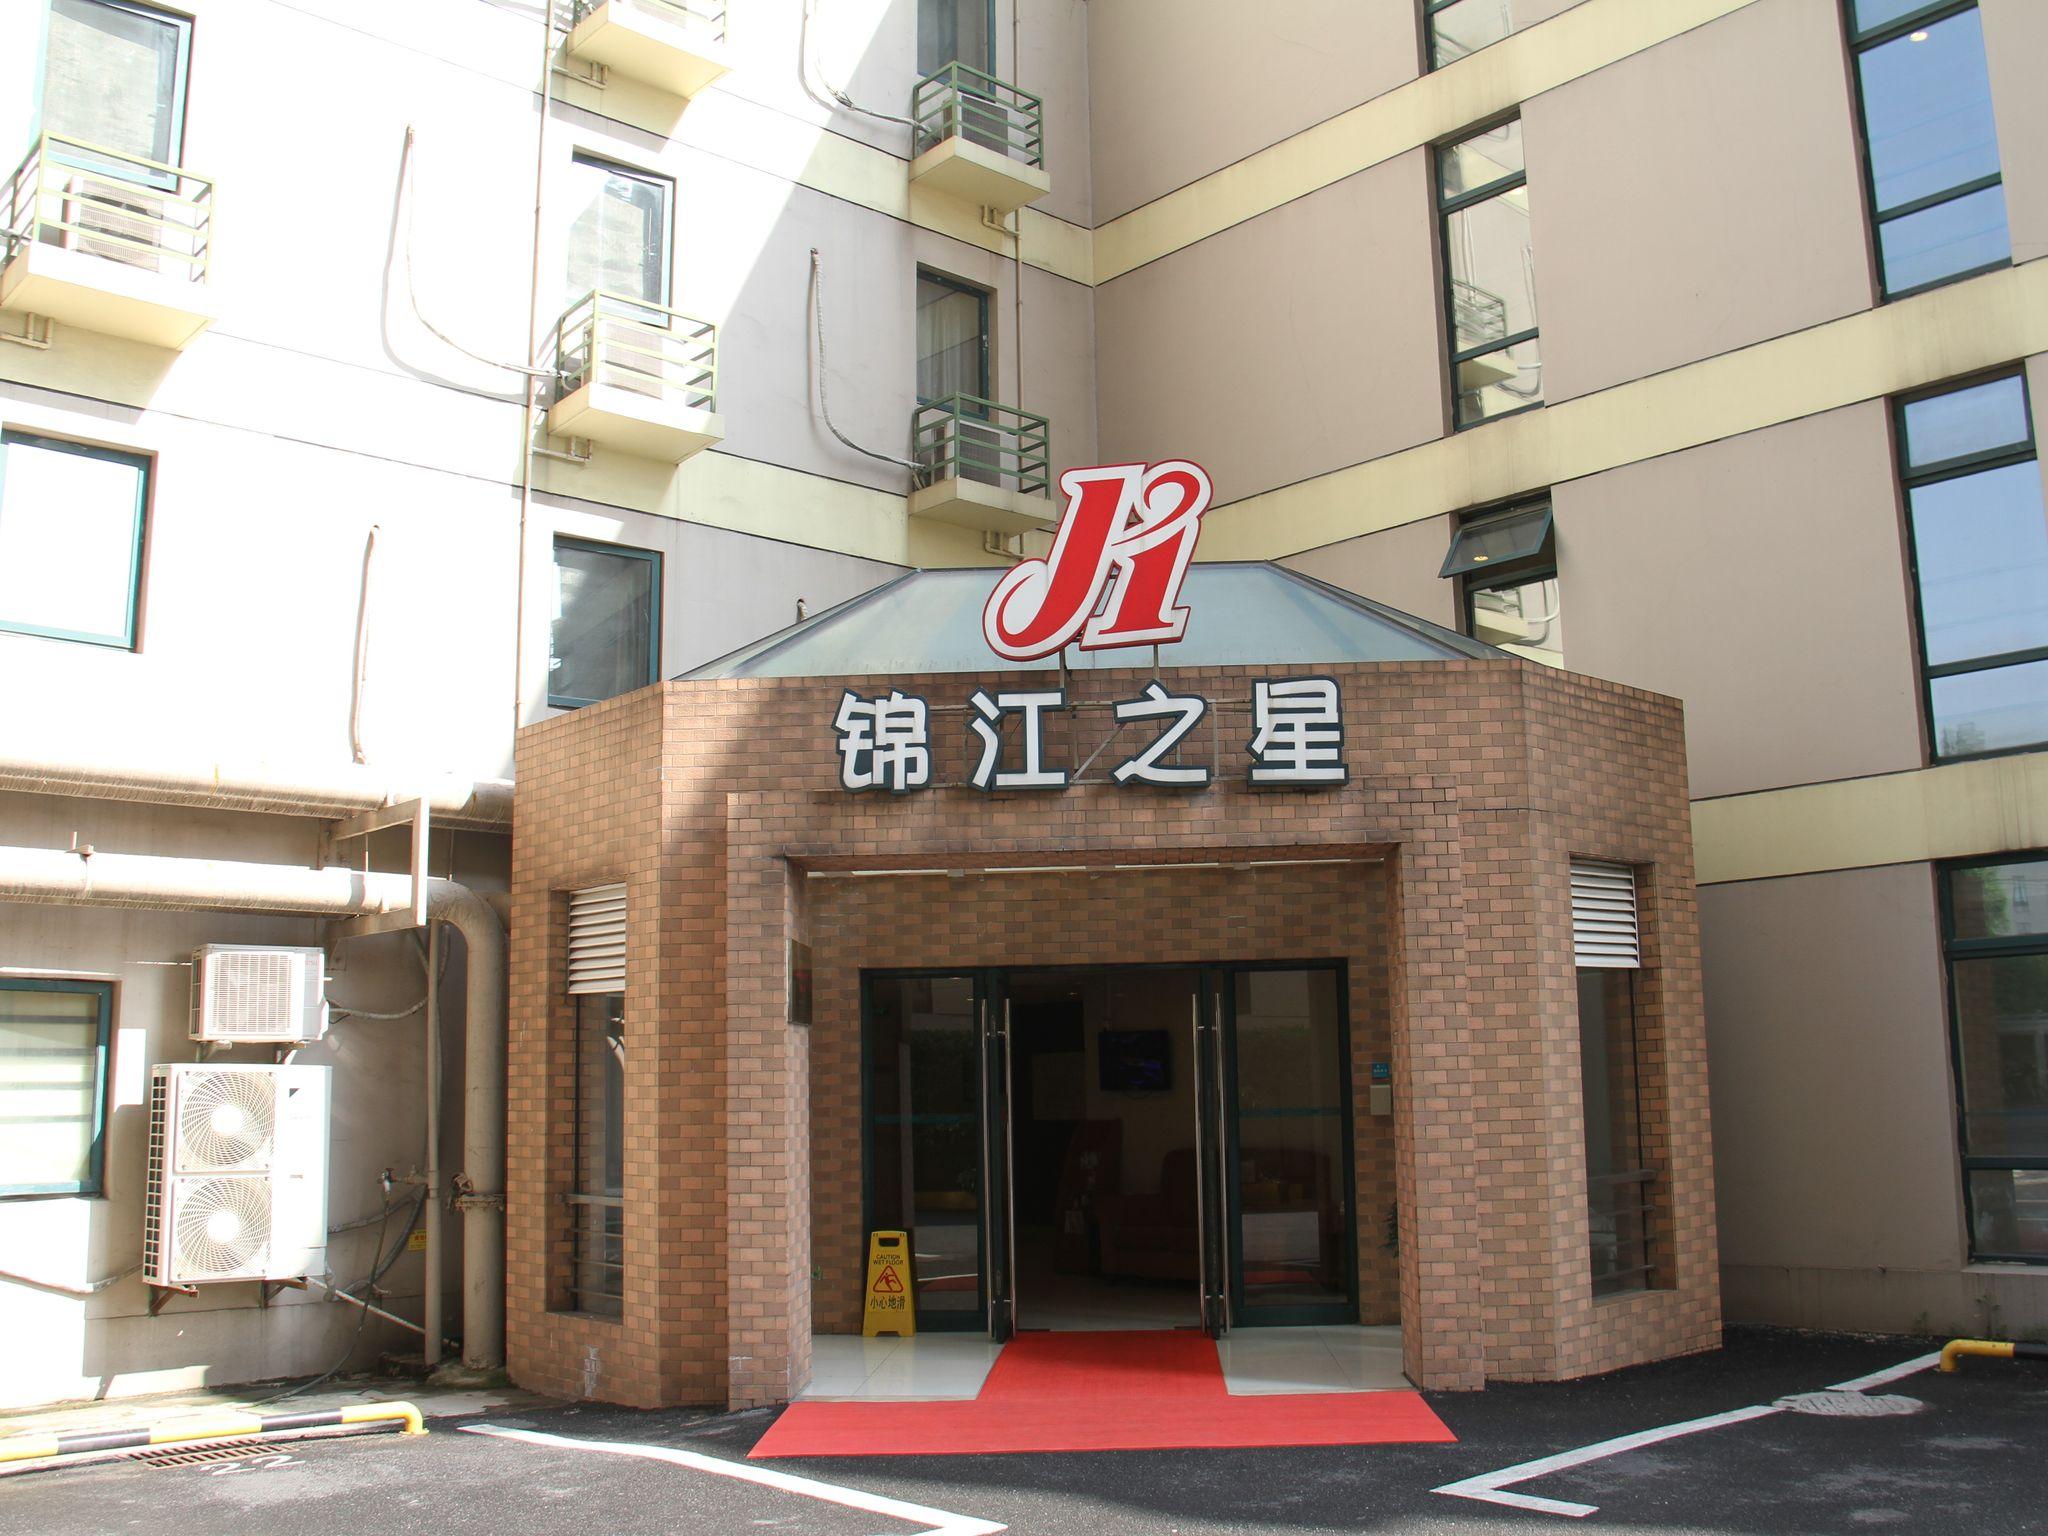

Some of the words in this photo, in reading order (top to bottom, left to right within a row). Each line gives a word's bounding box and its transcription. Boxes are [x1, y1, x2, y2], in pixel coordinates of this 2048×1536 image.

[832, 677, 1348, 794] 锦江之星
[870, 1296, 905, 1310] 小心地滑
